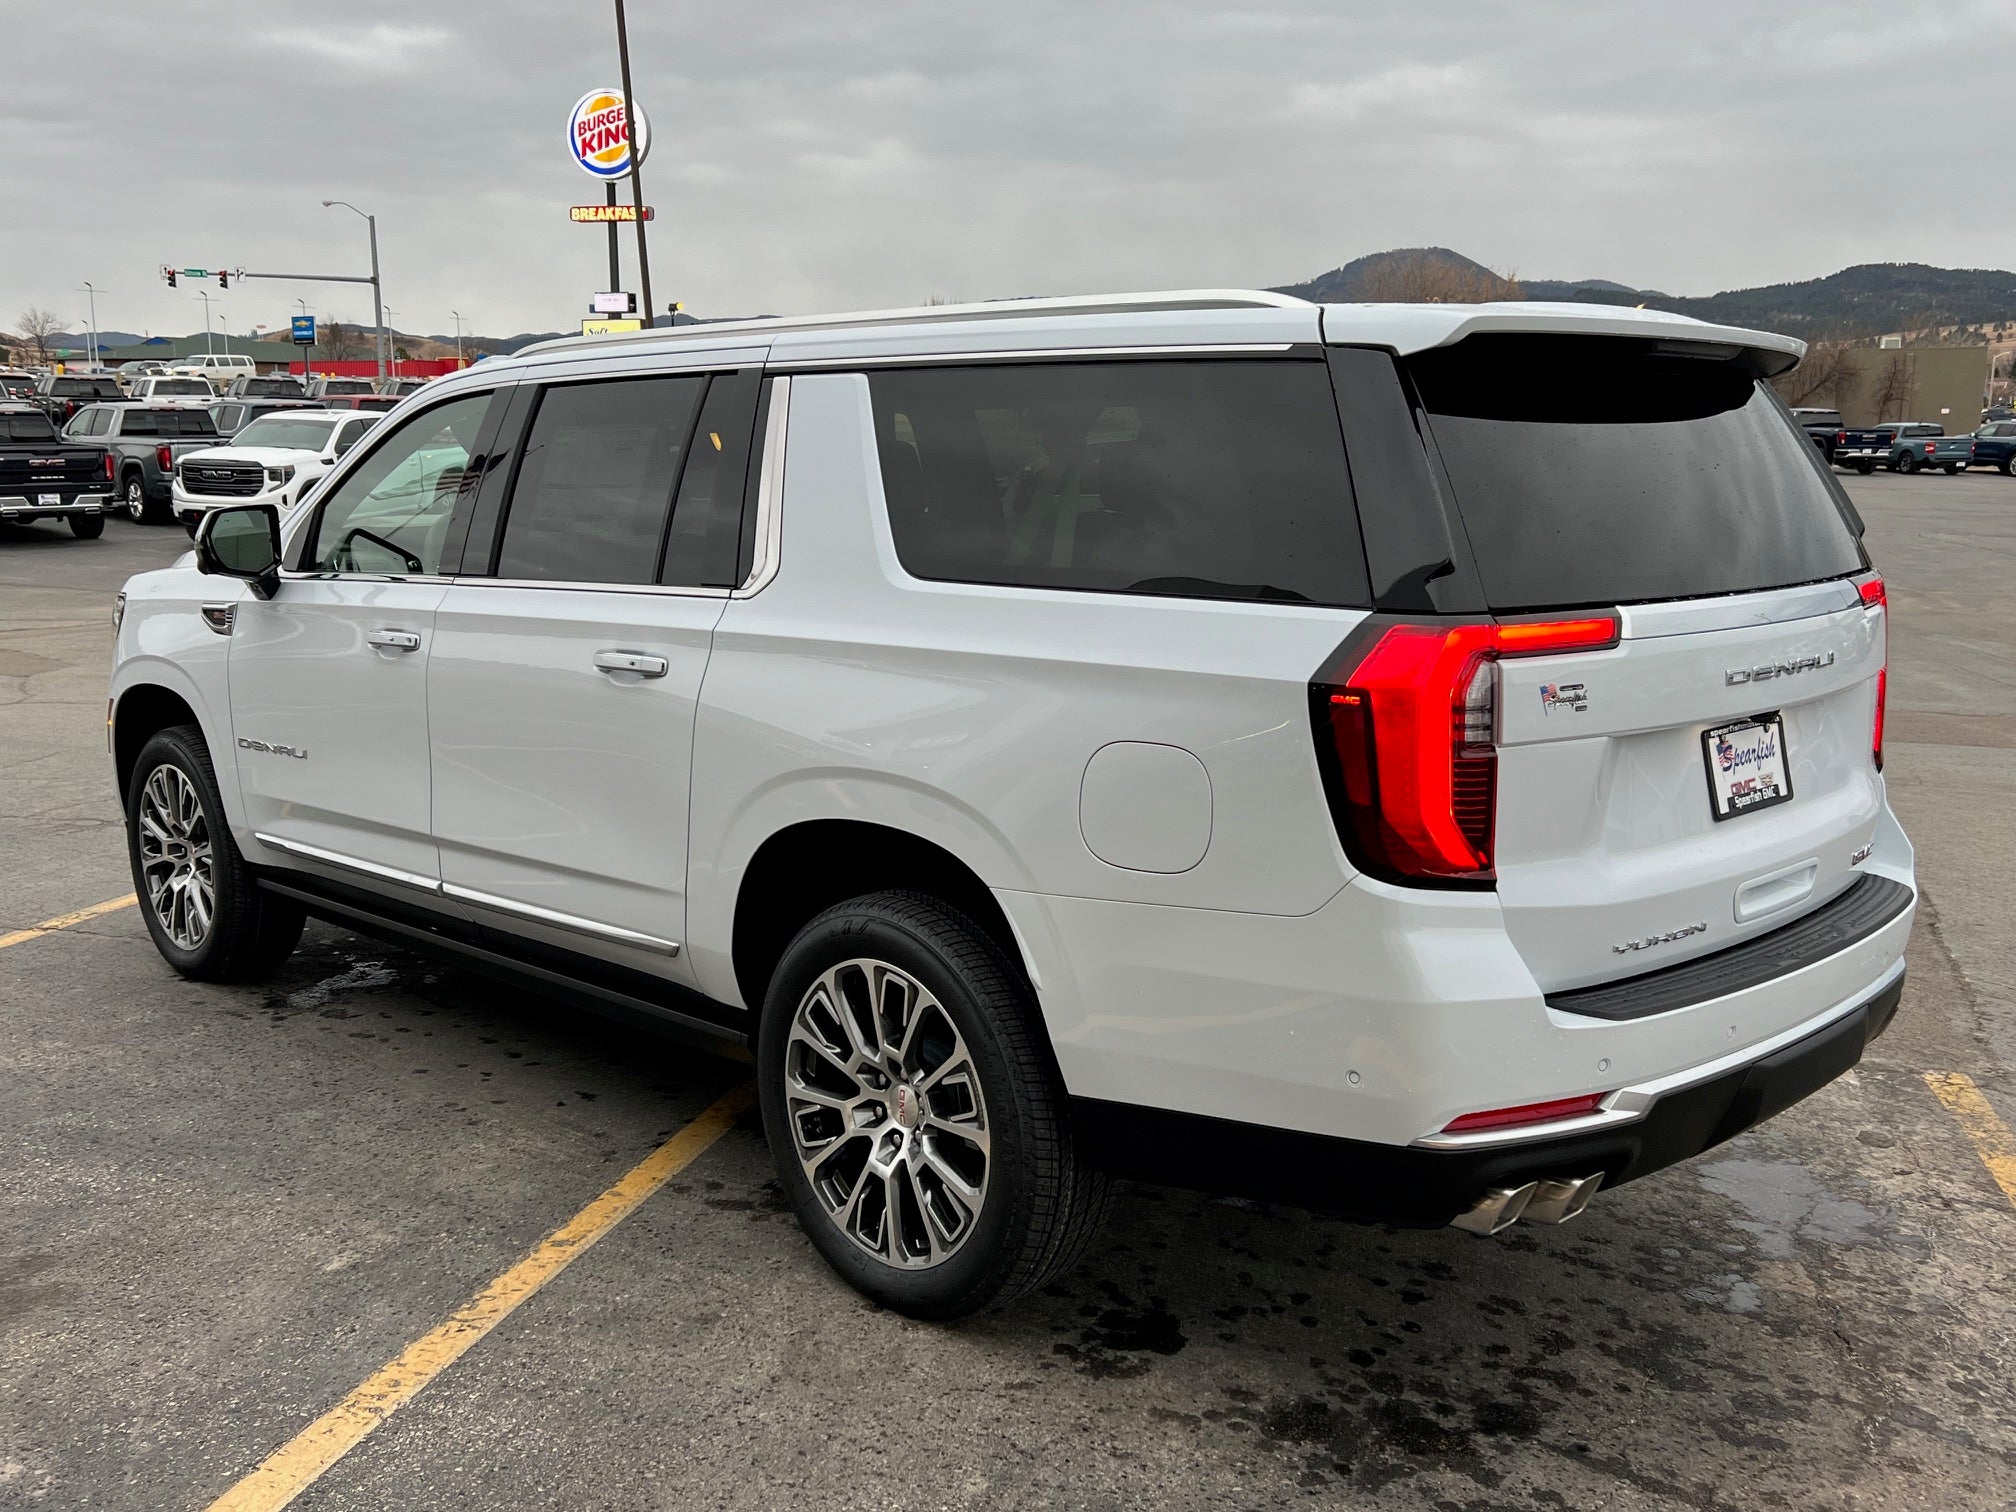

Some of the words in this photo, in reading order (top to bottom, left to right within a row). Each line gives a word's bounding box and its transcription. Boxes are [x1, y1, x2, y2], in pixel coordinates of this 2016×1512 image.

[577, 106, 624, 138] BURGE
[571, 206, 646, 221] BREAKFAS
[1725, 650, 1834, 687] DENALI
[238, 737, 308, 760] DENALI
[1722, 732, 1776, 775] Spearfish
[1730, 778, 1757, 796] GMC
[1734, 790, 1762, 809] Spearfish
[1612, 921, 1708, 954] YUKON
